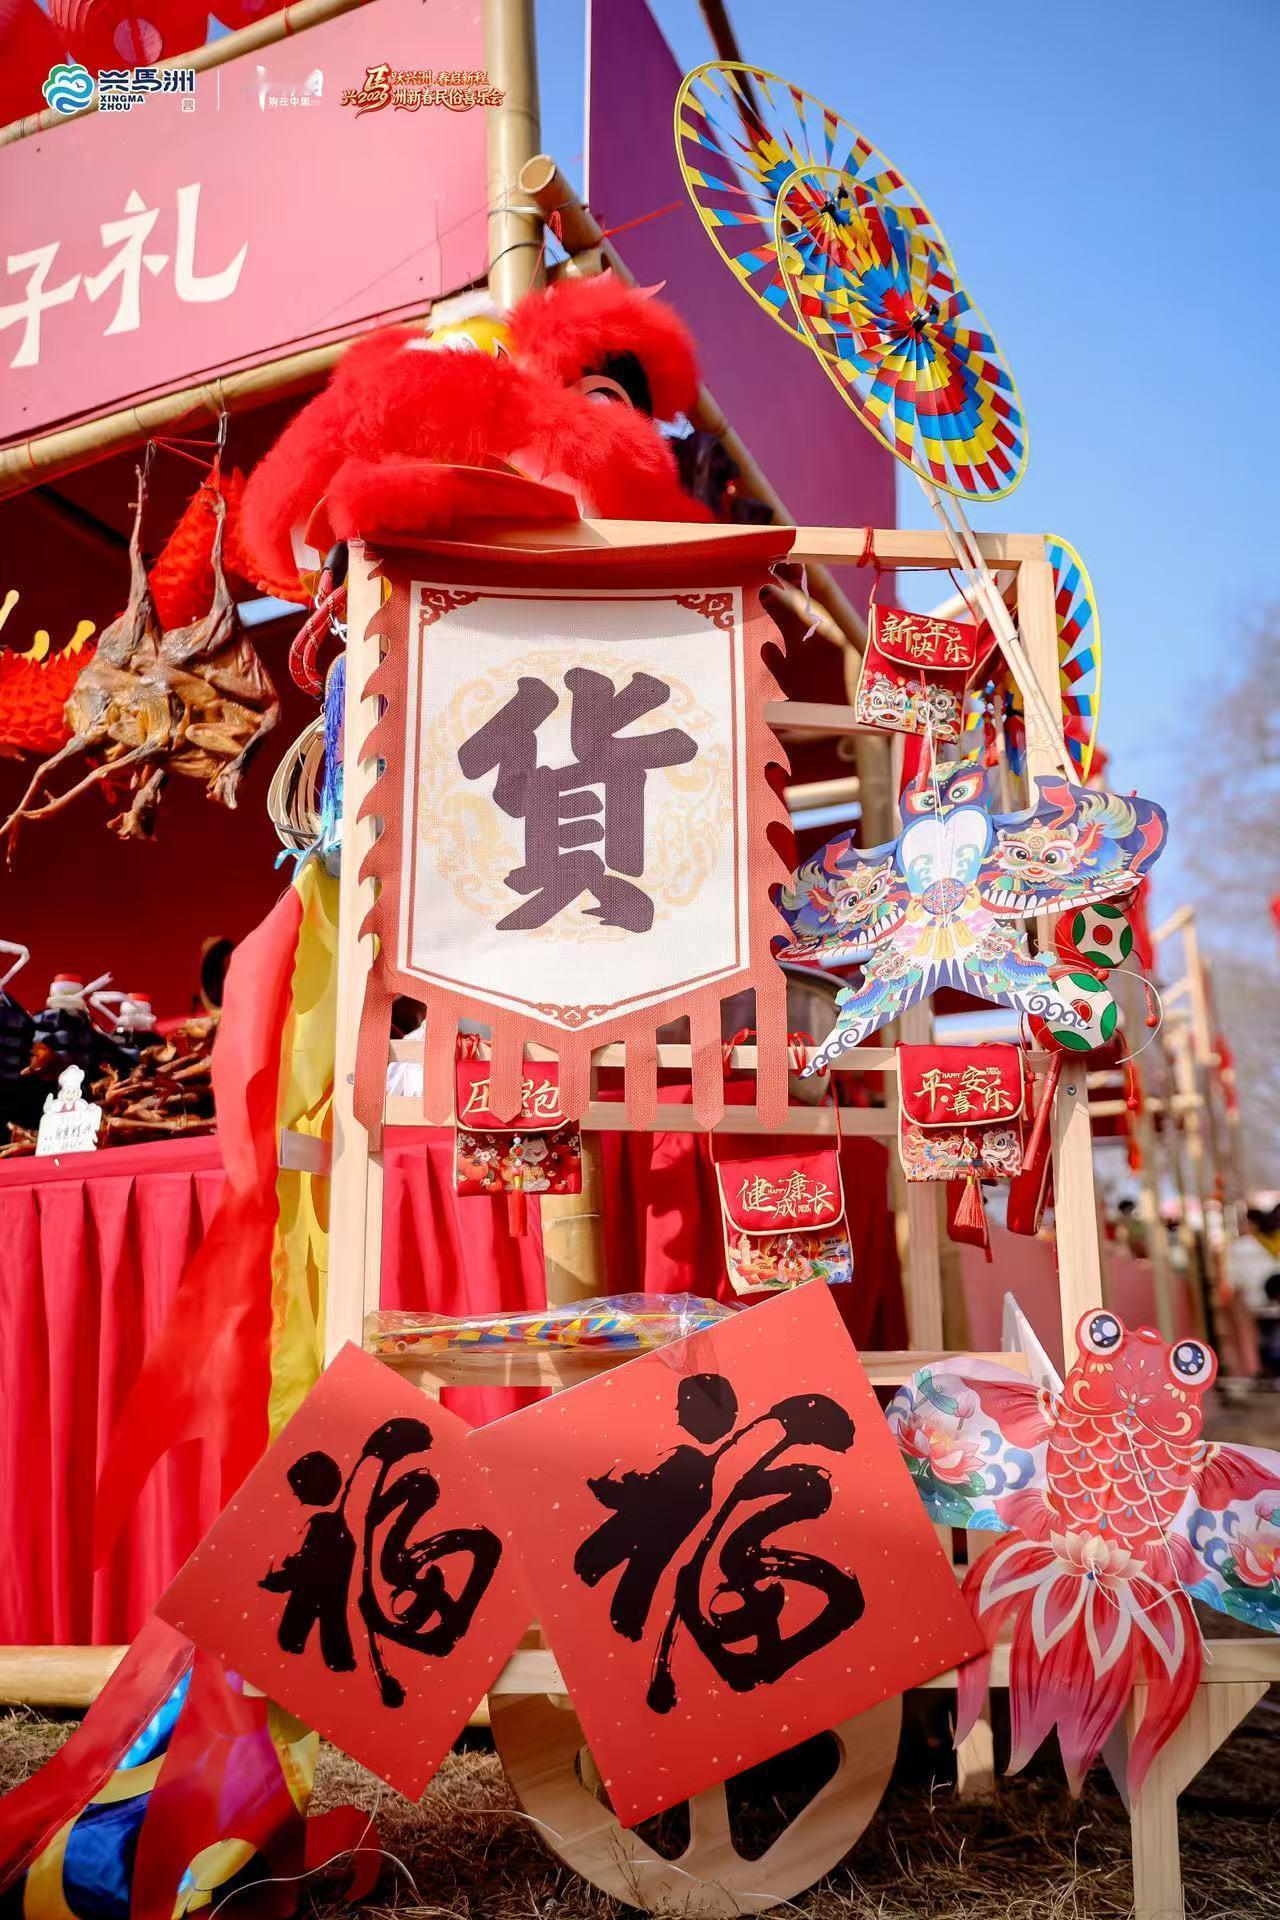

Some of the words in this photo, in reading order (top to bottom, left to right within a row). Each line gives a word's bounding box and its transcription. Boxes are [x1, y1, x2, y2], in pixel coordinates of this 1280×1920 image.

[881, 612, 971, 663] 新年快乐
[461, 1079, 562, 1118] 压包
[912, 1065, 1014, 1115] 平安喜乐
[736, 1169, 836, 1219] 健康成长
[257, 1417, 503, 1709] 福
[574, 1373, 866, 1715] 福
